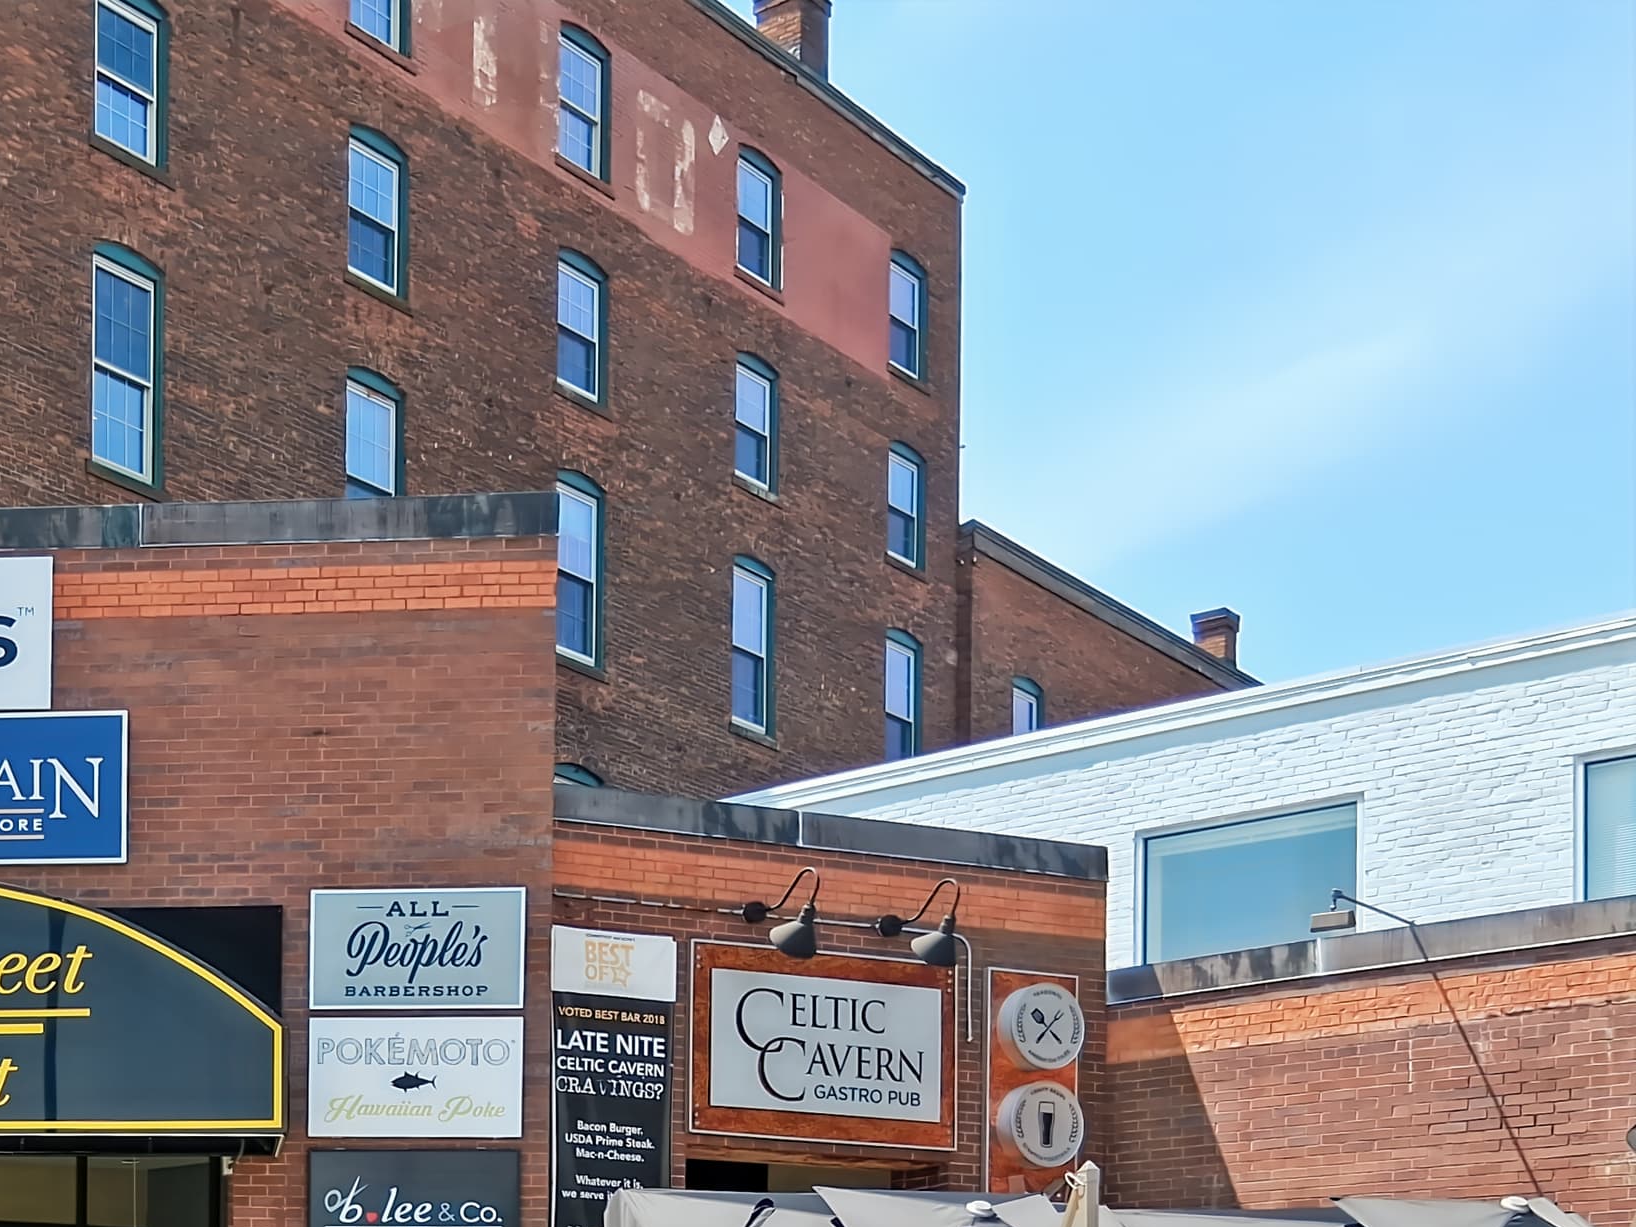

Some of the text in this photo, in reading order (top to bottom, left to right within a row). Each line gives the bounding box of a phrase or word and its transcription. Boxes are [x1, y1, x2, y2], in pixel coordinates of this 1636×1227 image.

[386, 901, 450, 917] ALL
[345, 920, 489, 984] People's
[584, 940, 635, 967] BEST
[584, 964, 609, 981] OF
[345, 985, 489, 997] BARBERSHOP
[558, 1006, 593, 1018] VOTED
[594, 1009, 620, 1021] BEST
[621, 1012, 641, 1023] BAR
[734, 987, 887, 1053] CELTIC
[316, 1033, 511, 1066] POKÉMOTO
[556, 1029, 666, 1058] LATE NITE
[556, 1056, 665, 1077] CELTIC CAVERN
[757, 1037, 925, 1102] CAVERN
[555, 1075, 664, 1100] CRAVINGS?
[813, 1084, 922, 1107] GASTRO PUB
[324, 1095, 506, 1123] Hawaiian Poke
[576, 1120, 607, 1133] Bacon
[565, 1133, 593, 1144] USDA
[595, 1136, 623, 1147] Prime
[575, 1174, 622, 1187] Whatever
[623, 1178, 631, 1188] it
[561, 1190, 577, 1198] we
[580, 1191, 605, 1200] serve
[438, 1202, 456, 1222] &
[459, 1201, 504, 1223] Co.
